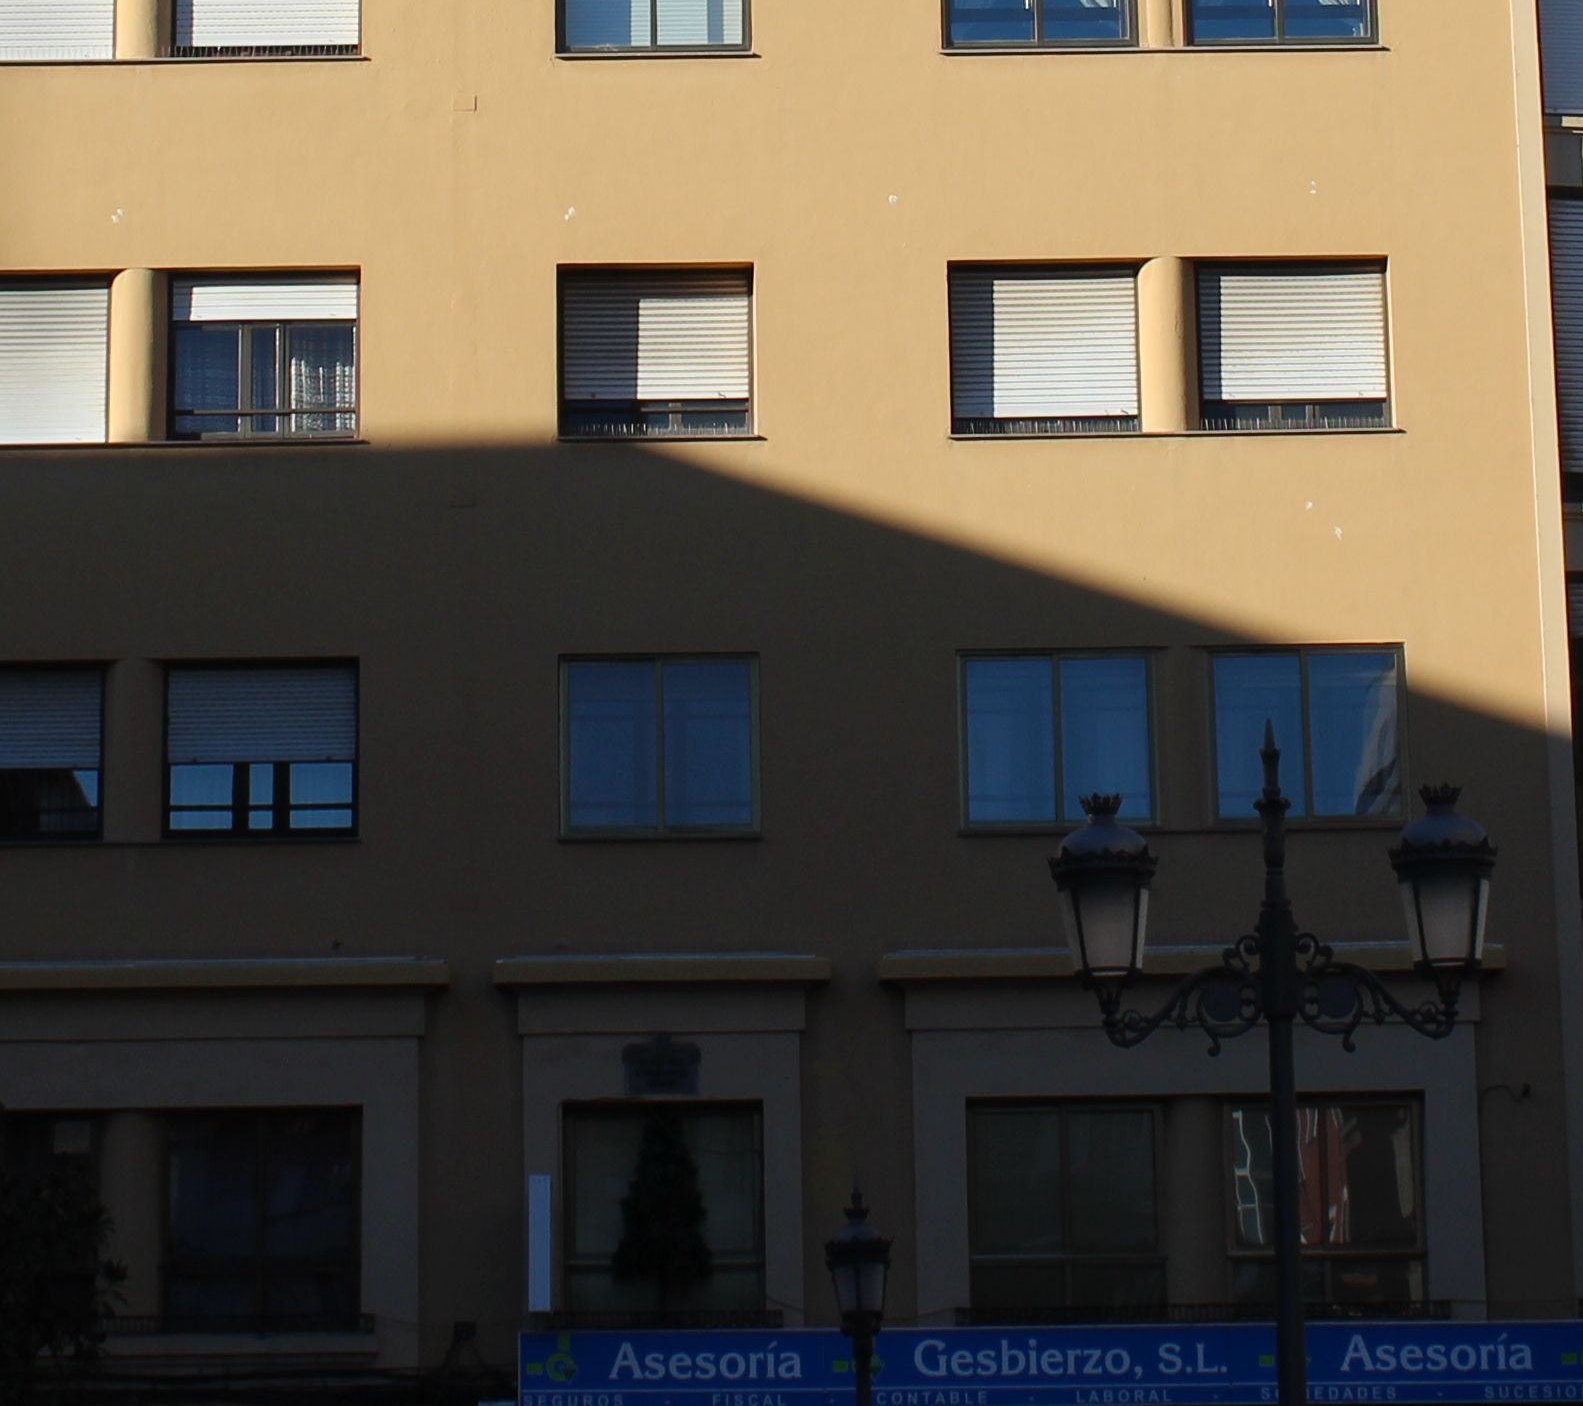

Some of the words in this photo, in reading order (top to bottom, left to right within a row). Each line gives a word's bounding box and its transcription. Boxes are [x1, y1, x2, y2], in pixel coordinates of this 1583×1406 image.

[608, 1340, 802, 1380] Asesoría
[914, 1338, 1143, 1379] Gesbierzo,
[1157, 1342, 1228, 1375] S.L.
[1340, 1331, 1533, 1371] Asesoría
[523, 1394, 623, 1406] SEGUROS
[712, 1393, 787, 1406] FISCAL
[876, 1391, 988, 1405] CONTABLE
[1076, 1389, 1172, 1403] LABORAL
[1261, 1385, 1397, 1400] SIEDADES
